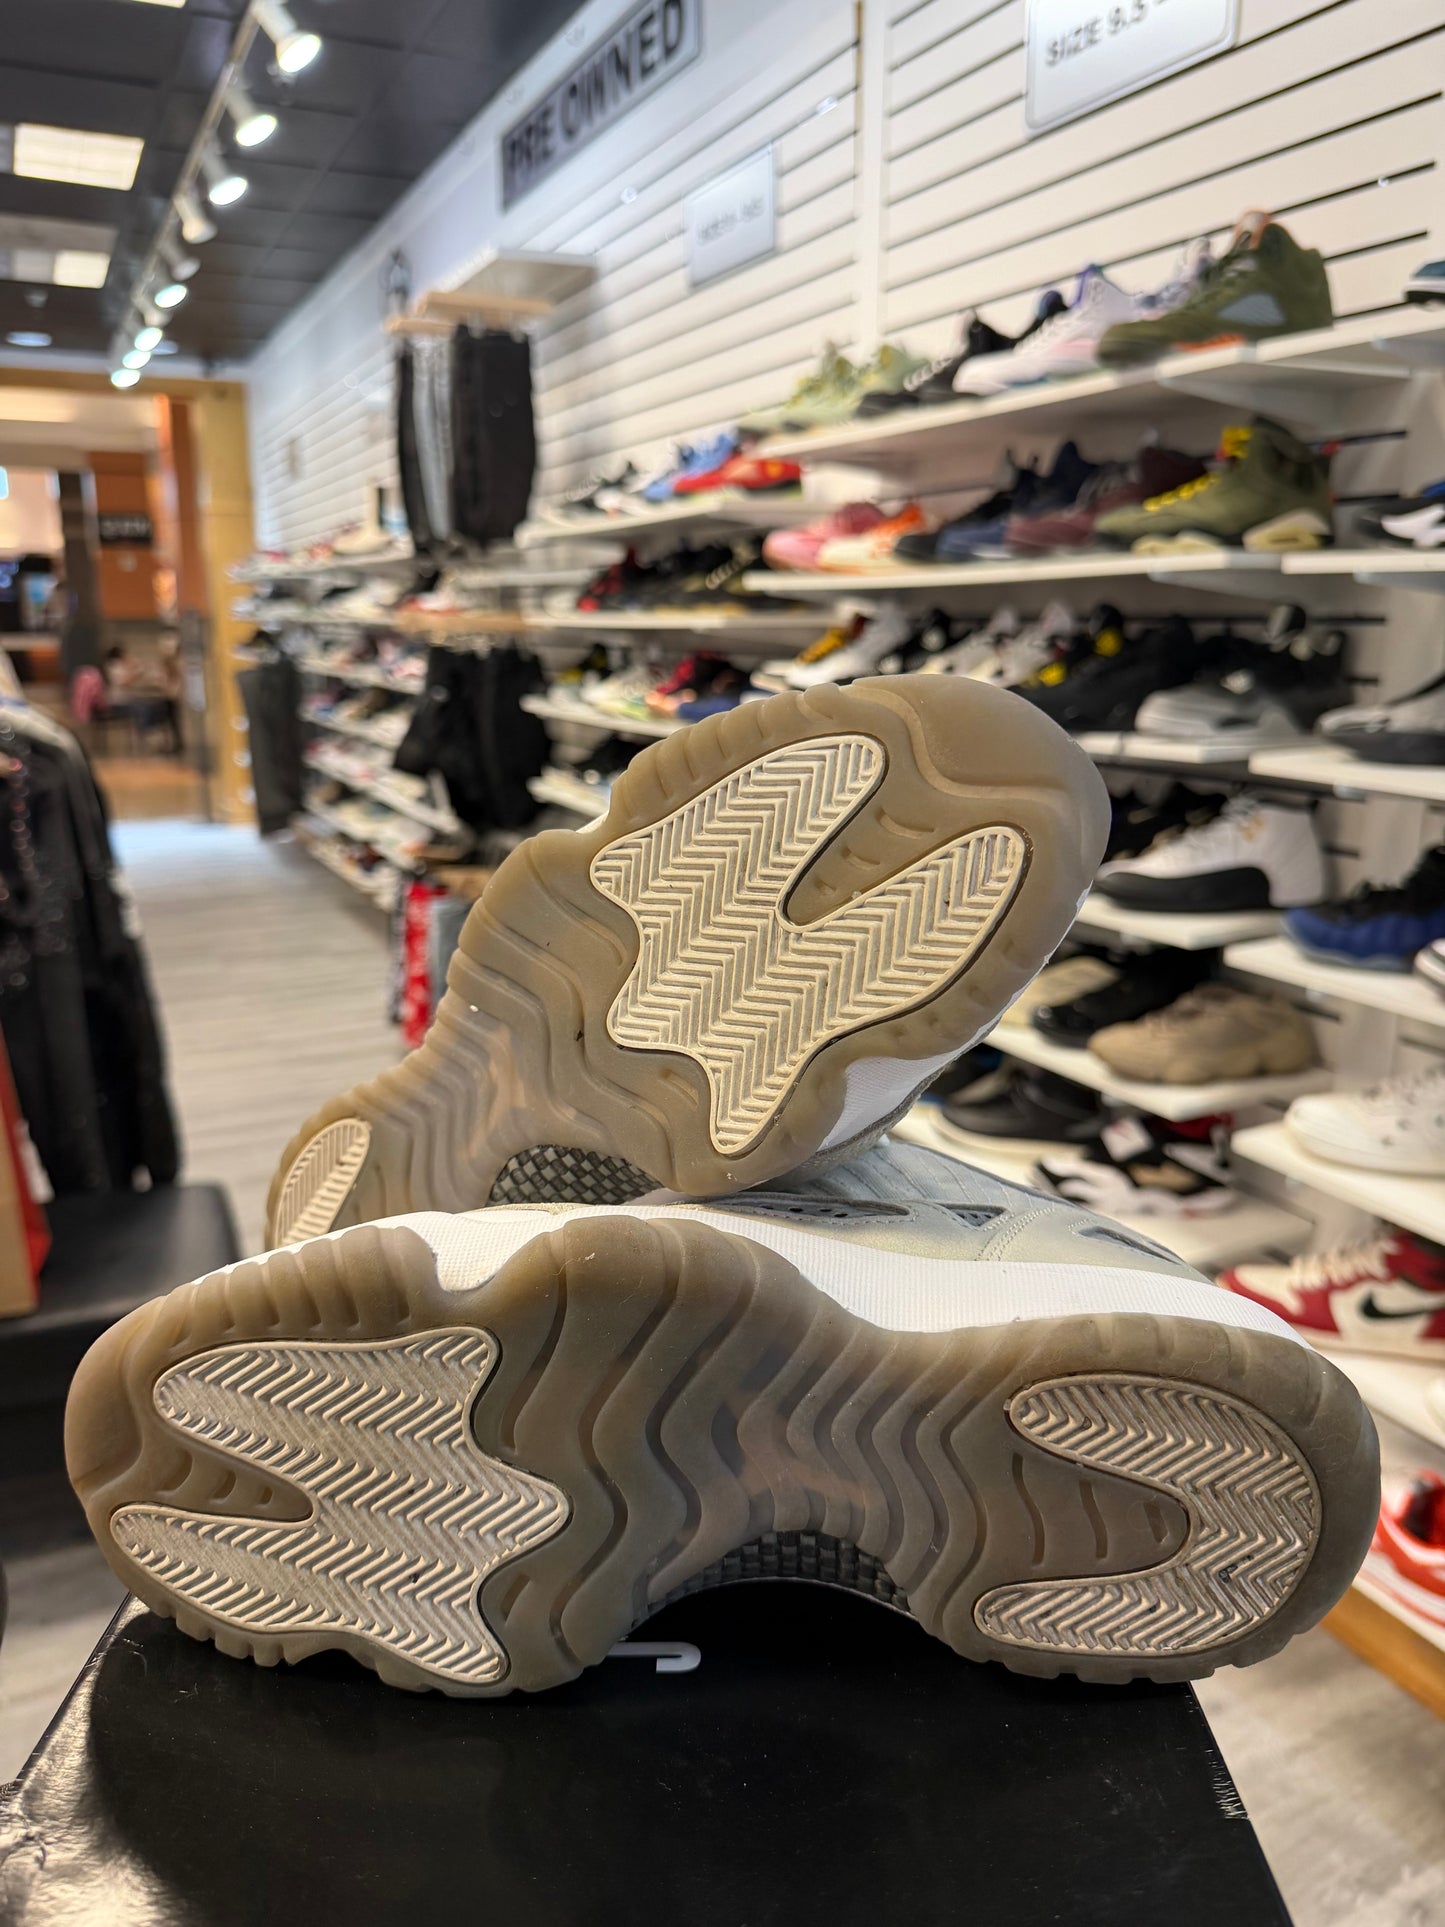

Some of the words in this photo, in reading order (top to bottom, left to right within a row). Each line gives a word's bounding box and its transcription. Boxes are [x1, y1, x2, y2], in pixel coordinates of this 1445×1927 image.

[508, 104, 556, 170] PRE
[560, 0, 684, 143] OWNED
[1046, 16, 1103, 67] SIZE
